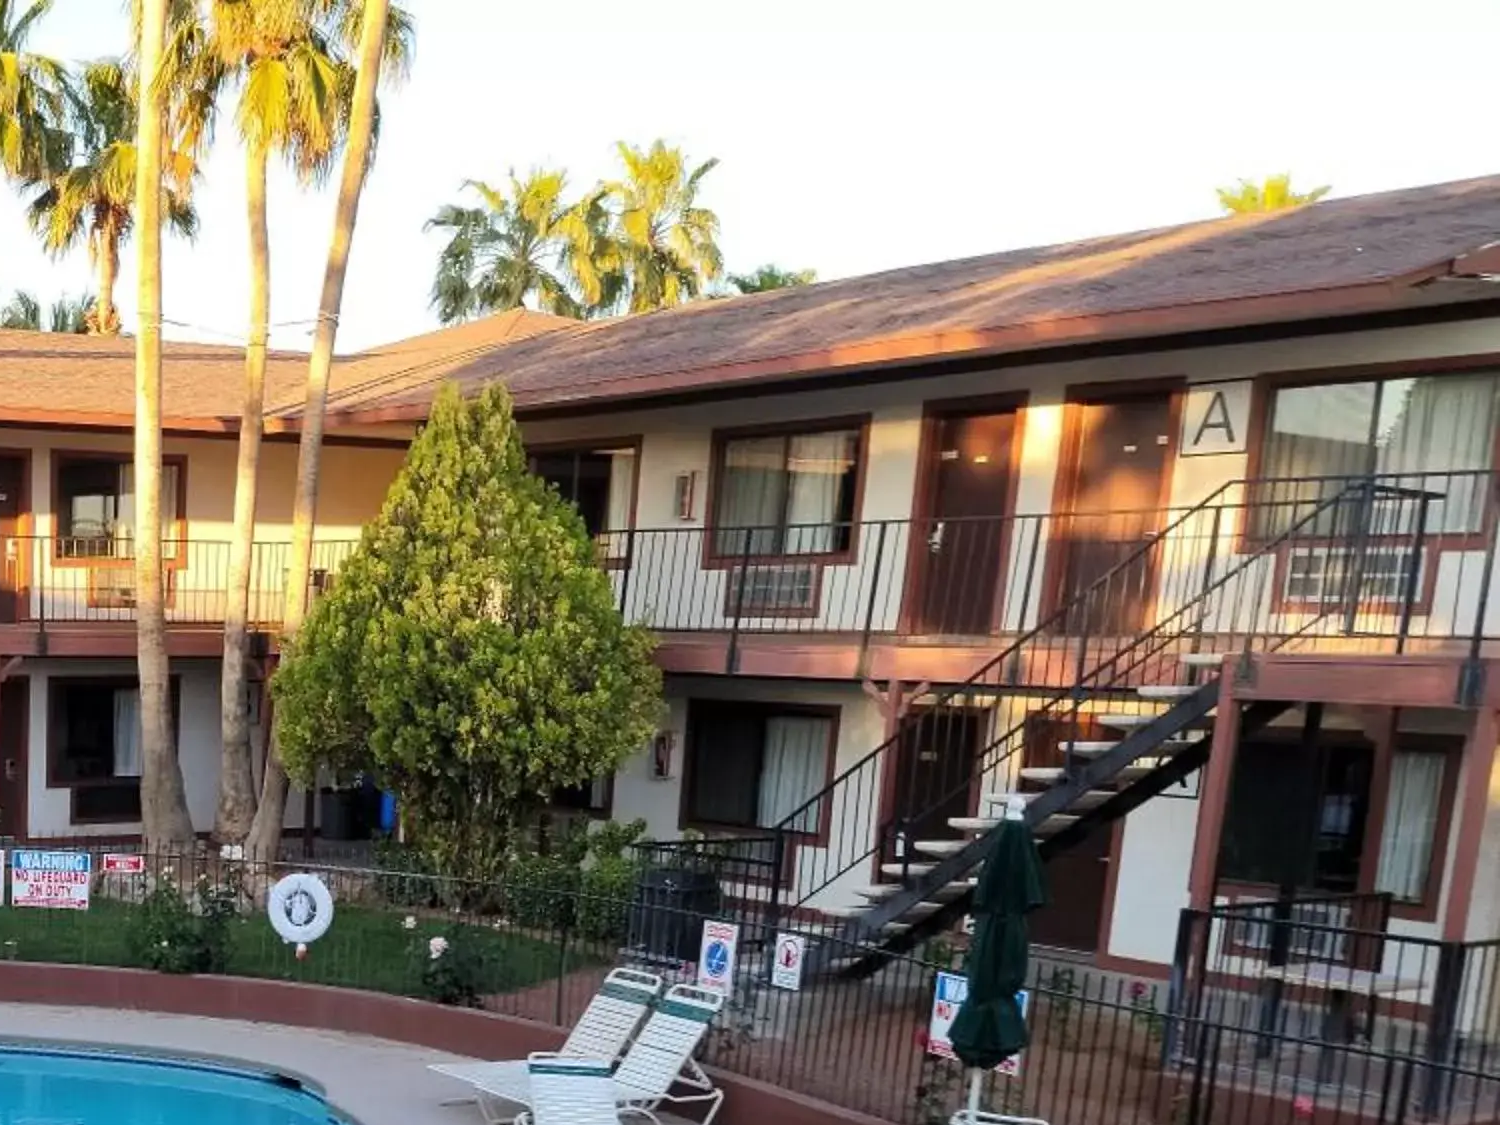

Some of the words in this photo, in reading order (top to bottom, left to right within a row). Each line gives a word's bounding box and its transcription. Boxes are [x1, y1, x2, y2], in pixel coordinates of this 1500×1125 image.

[1192, 391, 1236, 446] A
[19, 852, 84, 871] WARNING
[16, 869, 29, 881] NO
[33, 871, 87, 884] LIFEGUARD
[28, 883, 43, 896] ON
[46, 885, 73, 897] DUTY
